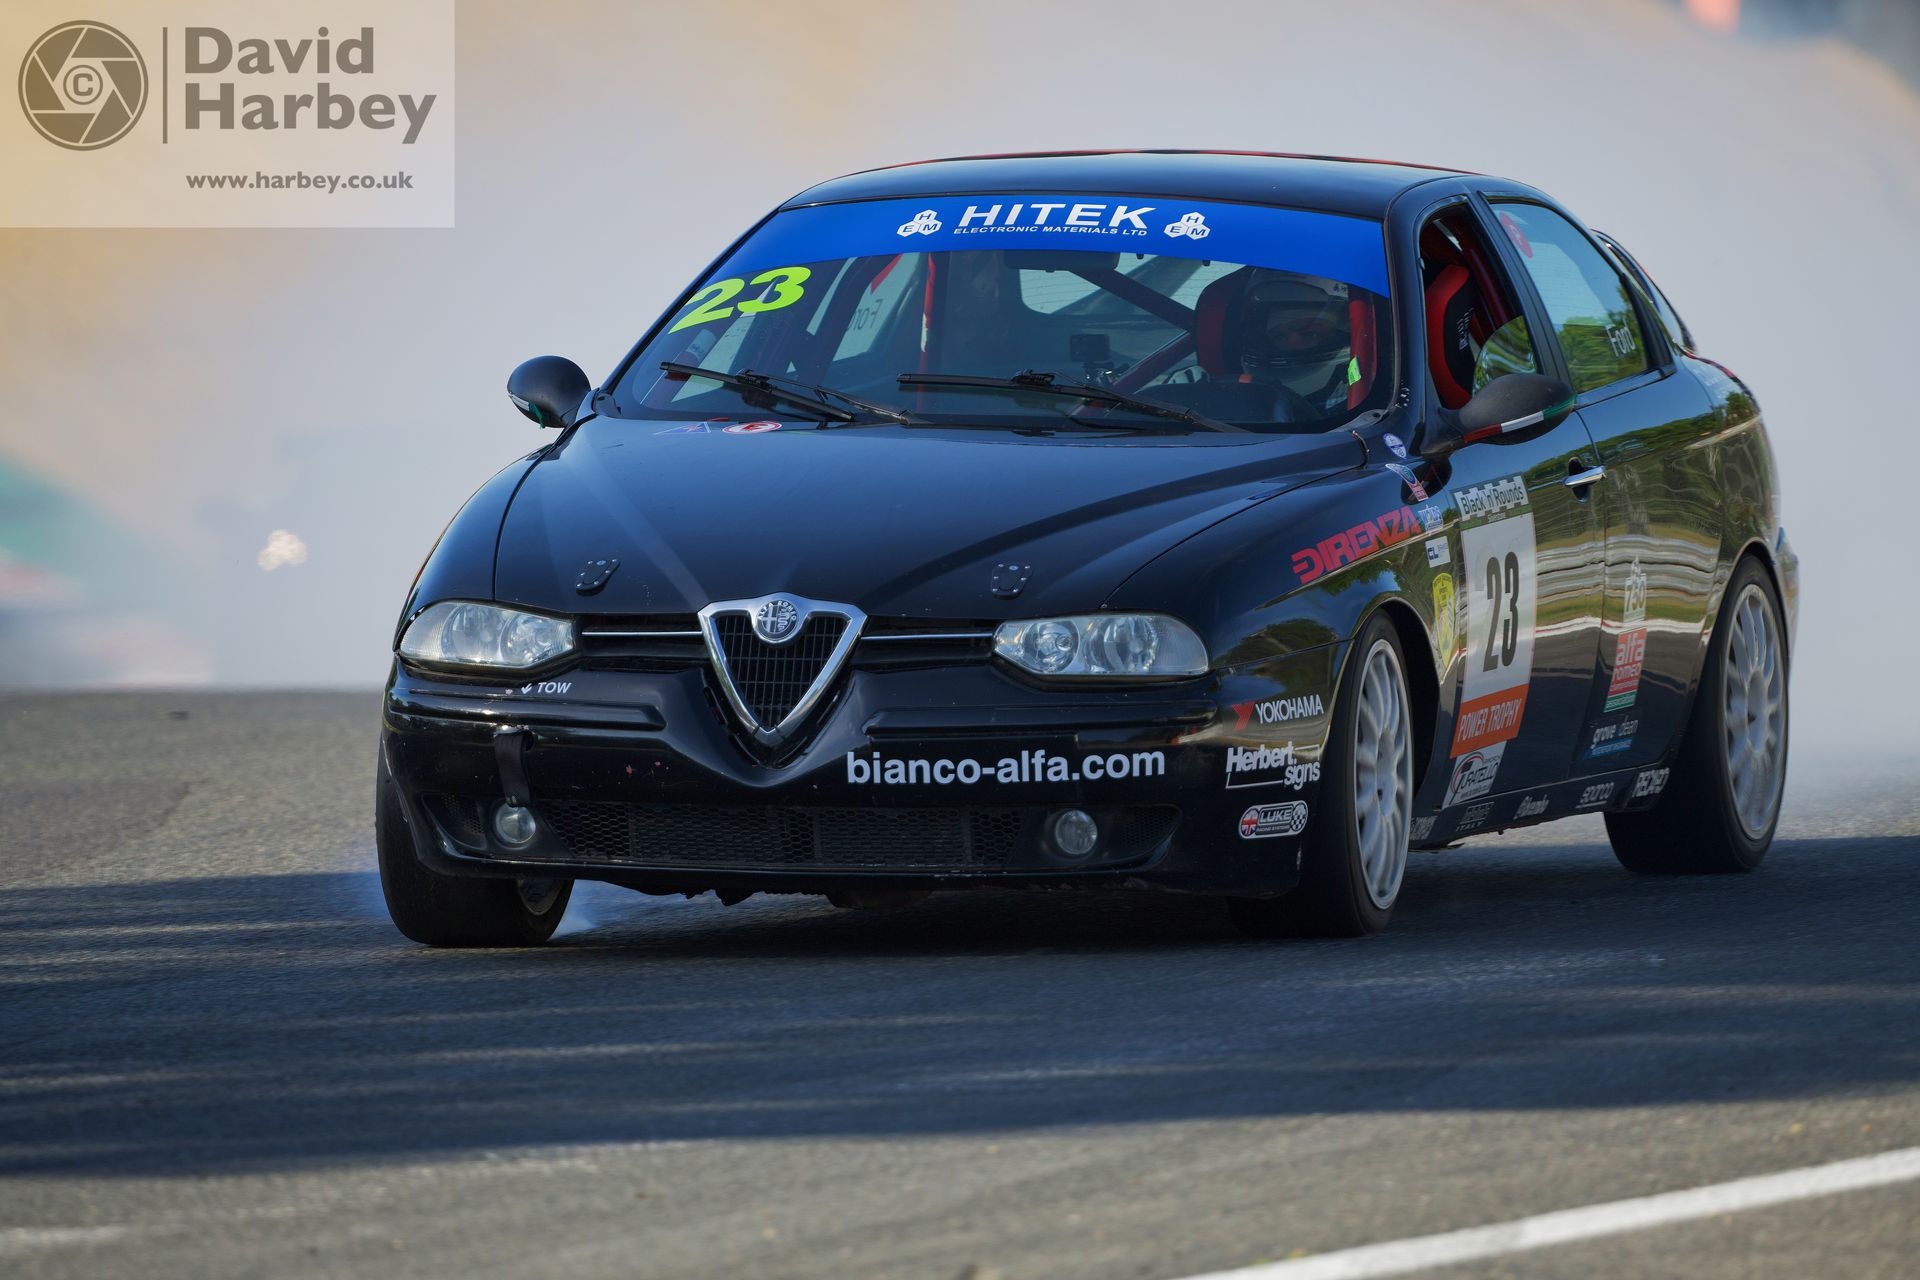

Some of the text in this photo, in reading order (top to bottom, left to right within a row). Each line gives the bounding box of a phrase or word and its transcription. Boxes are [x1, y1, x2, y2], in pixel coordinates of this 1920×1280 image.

[953, 225, 1148, 237] ELECTRONIC MATERIALS LTD
[958, 203, 1157, 229] HITEK
[668, 266, 812, 335] 23
[1460, 490, 1487, 515] Black
[1492, 483, 1524, 508] Rounds
[1291, 505, 1422, 584] DIRENZA
[1483, 551, 1520, 673] 23
[1615, 633, 1646, 666] alfa
[537, 681, 572, 694] TOW
[1255, 694, 1325, 725] YOKOHAMA
[1457, 698, 1522, 742] POWER TROPHY
[847, 749, 1166, 785] bianco-alfa.com
[1225, 740, 1294, 773] Herbert
[1283, 757, 1321, 791] signs
[1260, 809, 1293, 824] LUKE
